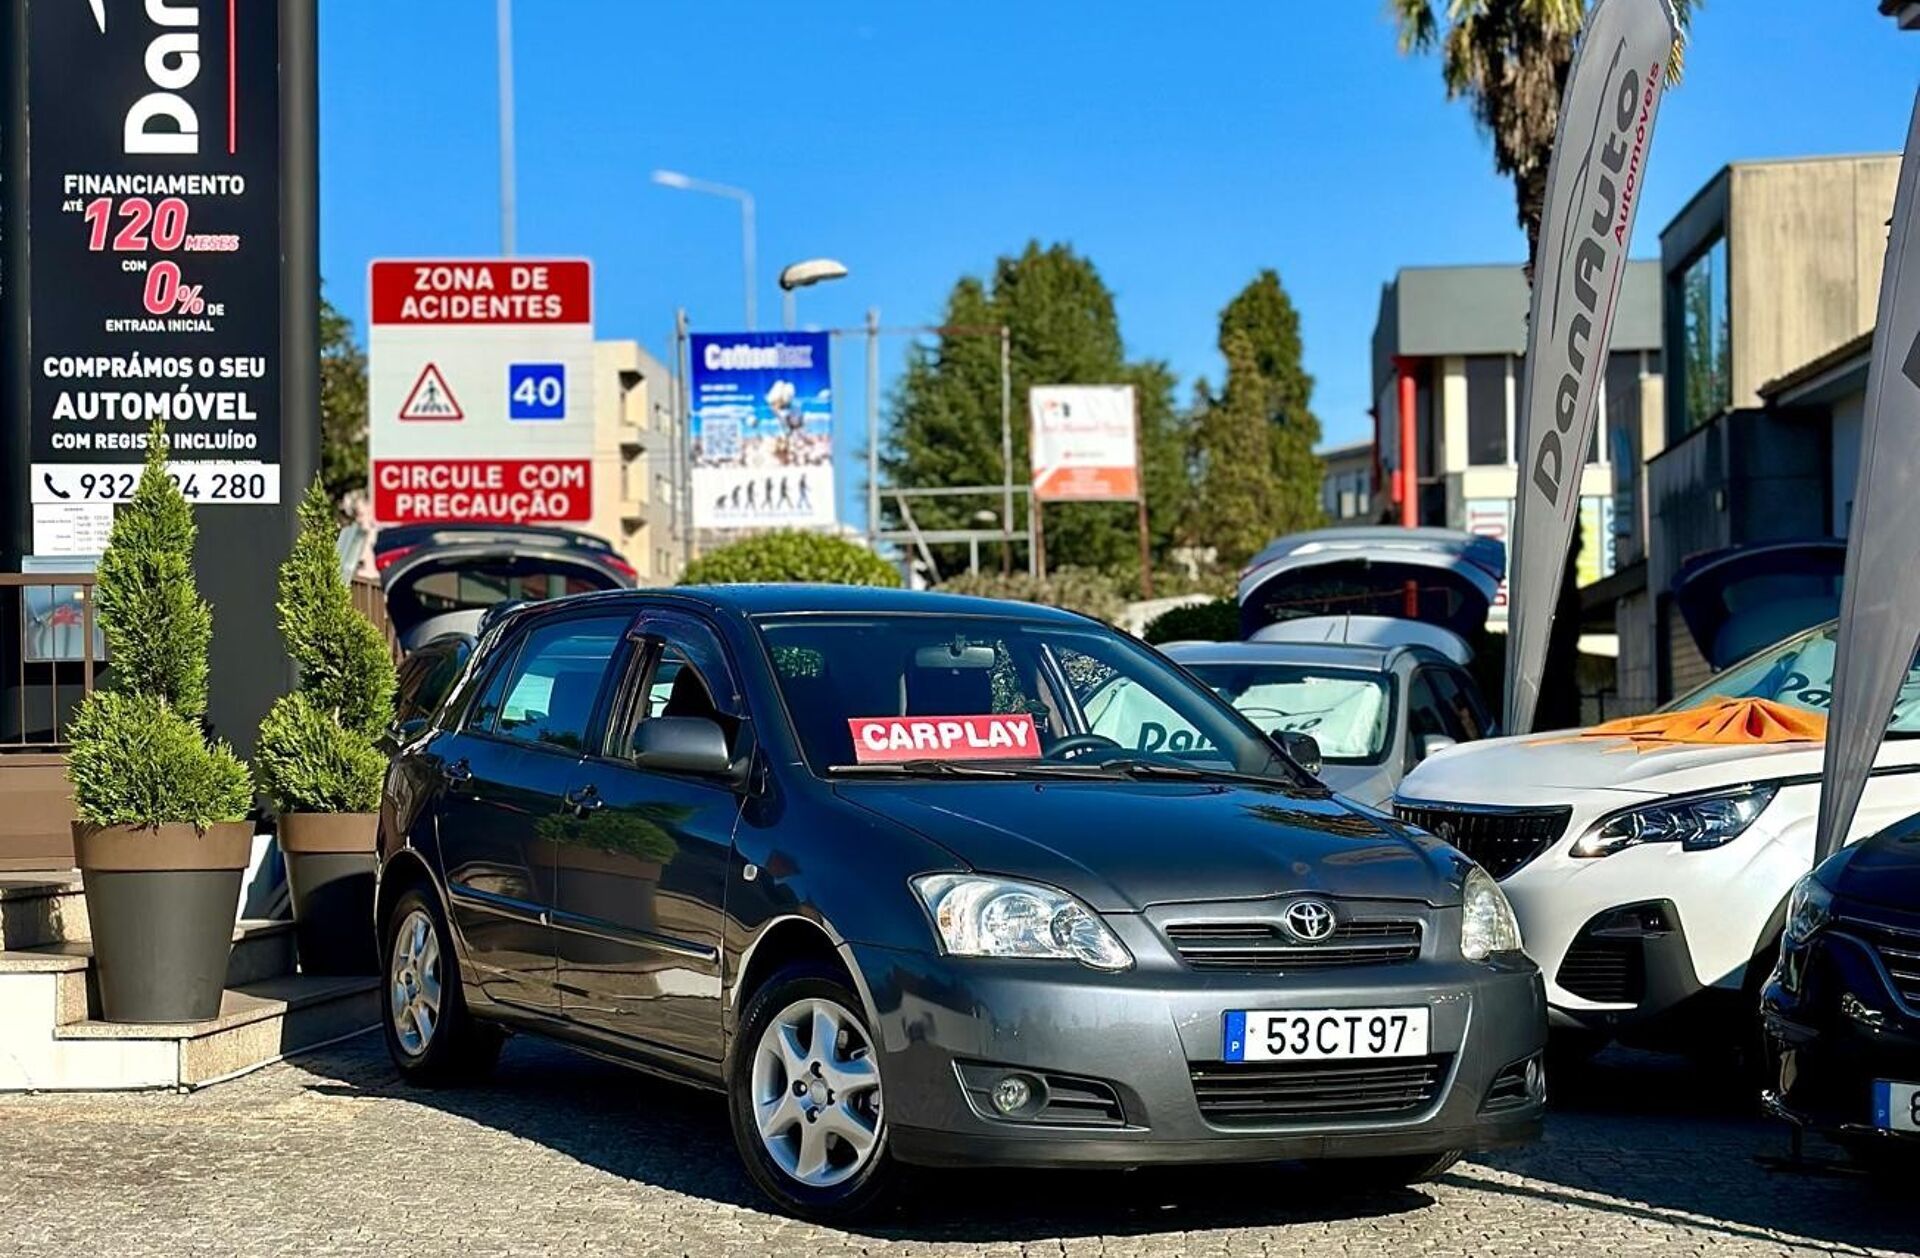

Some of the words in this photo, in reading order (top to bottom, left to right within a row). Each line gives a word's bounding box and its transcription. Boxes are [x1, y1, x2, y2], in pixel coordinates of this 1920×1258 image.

[1614, 60, 1661, 248] Automóveis
[64, 174, 245, 195] FINANCIAMENTO
[62, 200, 83, 212] ATÉ
[85, 198, 189, 251] 120
[185, 235, 239, 251] MESES
[122, 260, 147, 271] COM
[143, 260, 204, 315] 0%
[208, 304, 224, 316] DE
[414, 267, 494, 290] ZONA
[511, 267, 548, 290] DE
[1533, 68, 1640, 506] DanAuto
[401, 295, 562, 319] ACIDENTES
[106, 319, 166, 332] ENTRADA
[168, 319, 215, 332] INICIAL
[43, 352, 194, 378] COMPRÁMOS
[199, 358, 214, 378] O
[219, 358, 266, 378] SEU
[52, 384, 257, 421] AUTOMÓVEL
[513, 376, 562, 407] 40
[52, 433, 91, 449] COM
[95, 433, 170, 449] REGISO
[174, 429, 257, 449] INCLUÍDO
[80, 473, 134, 499] 932
[211, 473, 265, 499] 280
[380, 465, 503, 489] CIRCULE
[518, 465, 585, 489] COM
[396, 489, 570, 522] PRECAUÇÃO
[861, 719, 1030, 752] CARPLAY
[1231, 1041, 1240, 1052] P
[1266, 1015, 1408, 1055] 53CT97
